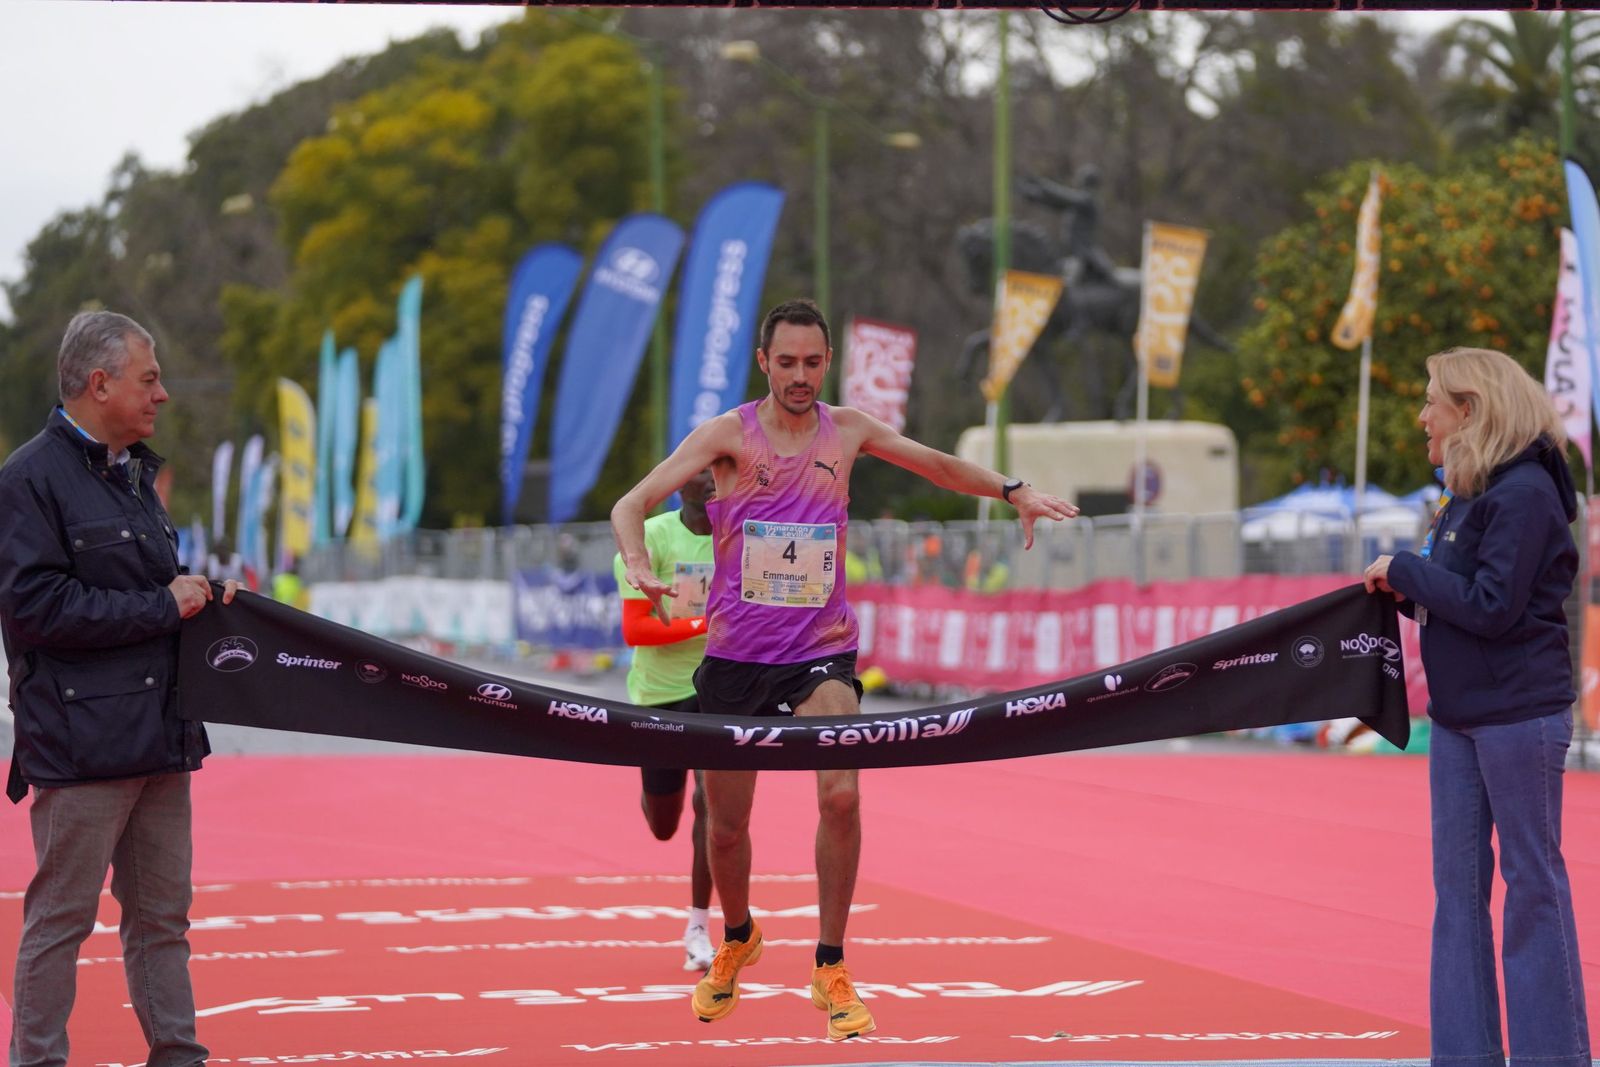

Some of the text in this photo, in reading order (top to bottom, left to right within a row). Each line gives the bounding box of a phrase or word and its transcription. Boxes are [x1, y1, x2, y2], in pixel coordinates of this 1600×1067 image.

[782, 540, 797, 564] 4
[700, 576, 711, 595] 1
[763, 571, 808, 582] Emmanuel
[276, 652, 342, 670] Sprinter
[1212, 651, 1278, 670] Sprinter
[469, 695, 518, 710] HYUNDAI
[547, 700, 609, 724] HOKA
[1005, 692, 1067, 717] HOKA
[817, 718, 943, 747] sevilla
